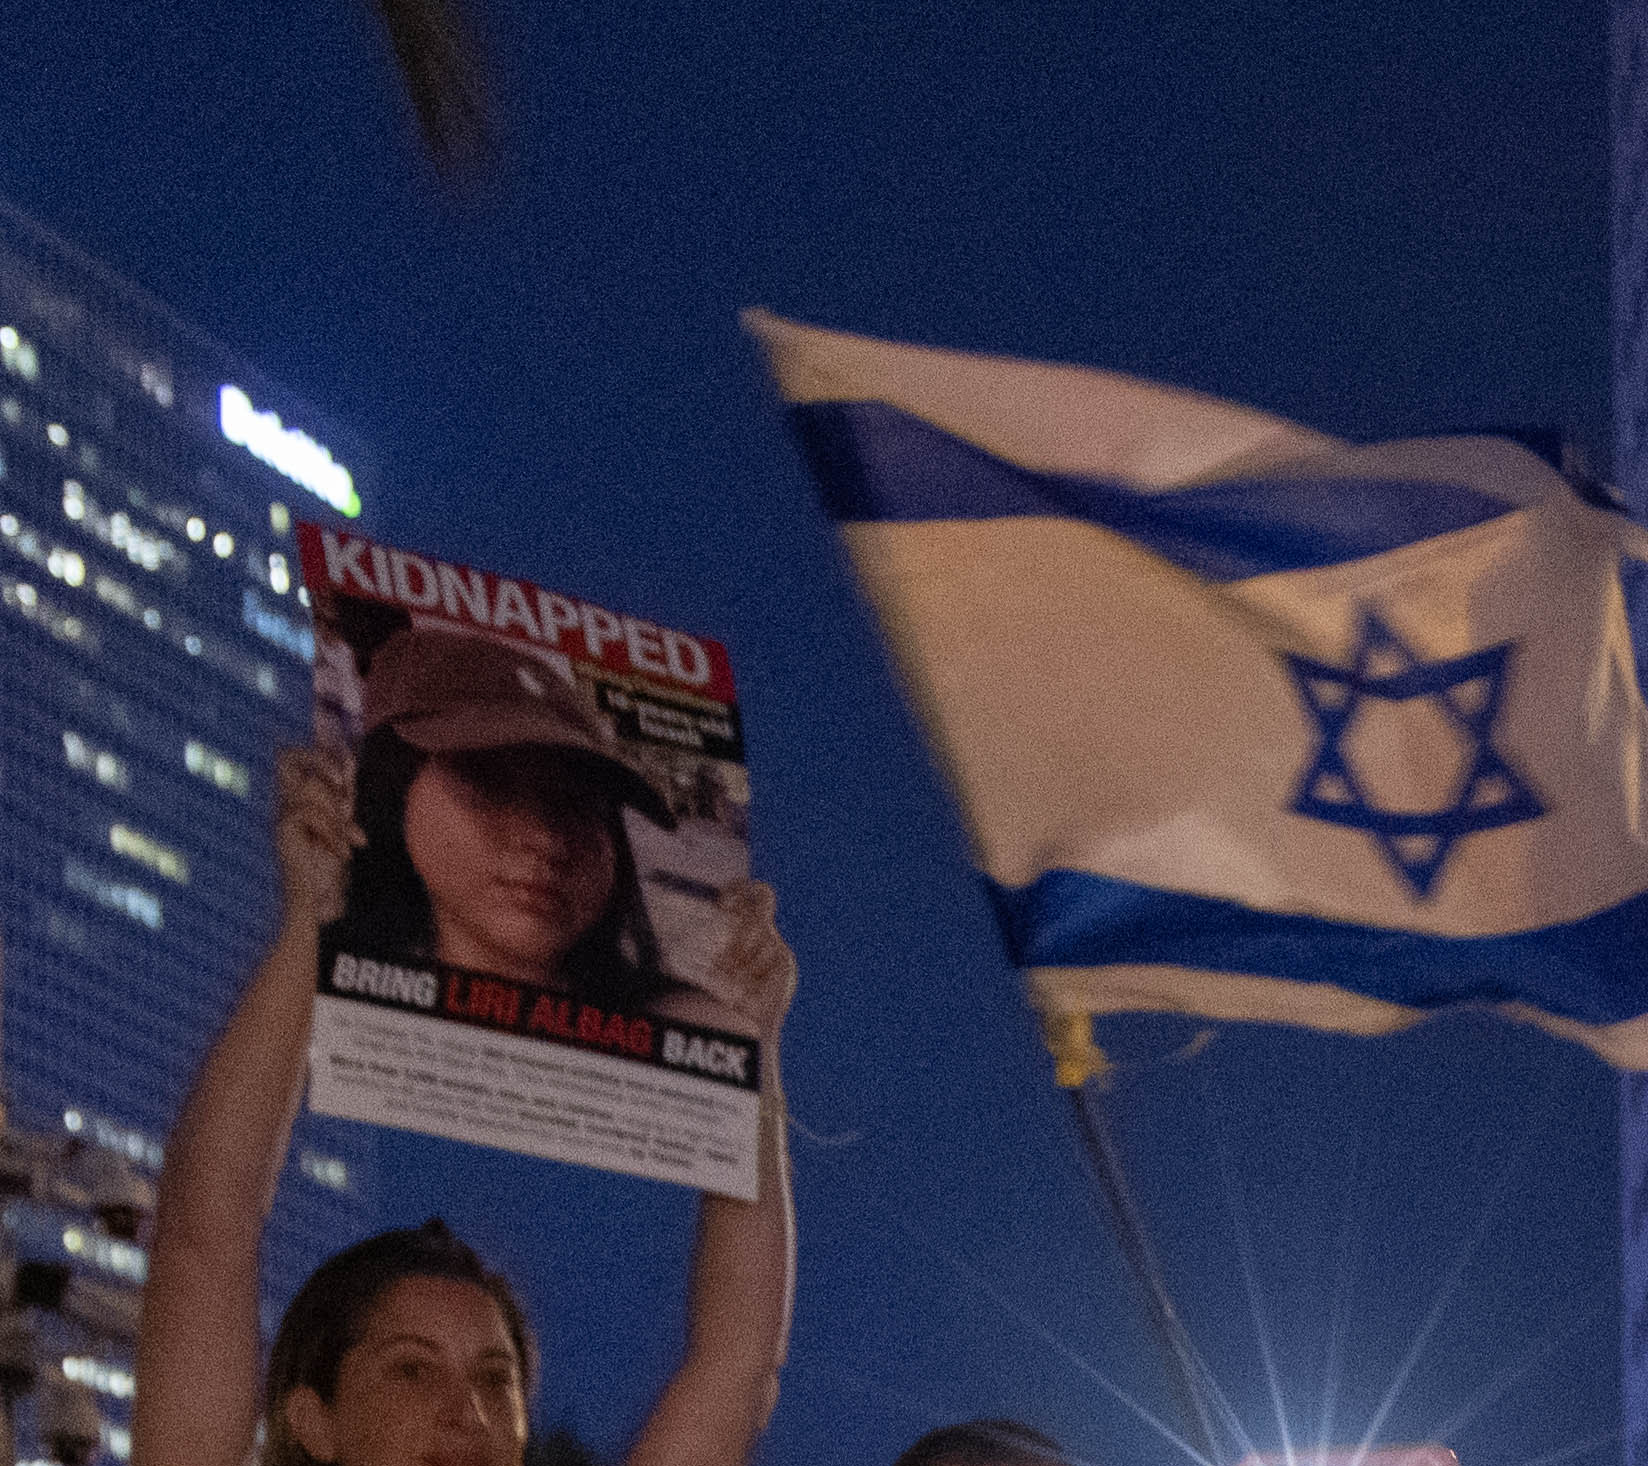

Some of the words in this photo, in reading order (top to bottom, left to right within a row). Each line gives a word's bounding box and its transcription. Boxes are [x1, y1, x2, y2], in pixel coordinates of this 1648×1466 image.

[320, 532, 713, 688] KIDNAPPED
[331, 952, 439, 1008] BRING
[527, 993, 653, 1058] ALBAG
[660, 1028, 749, 1081] BACK
